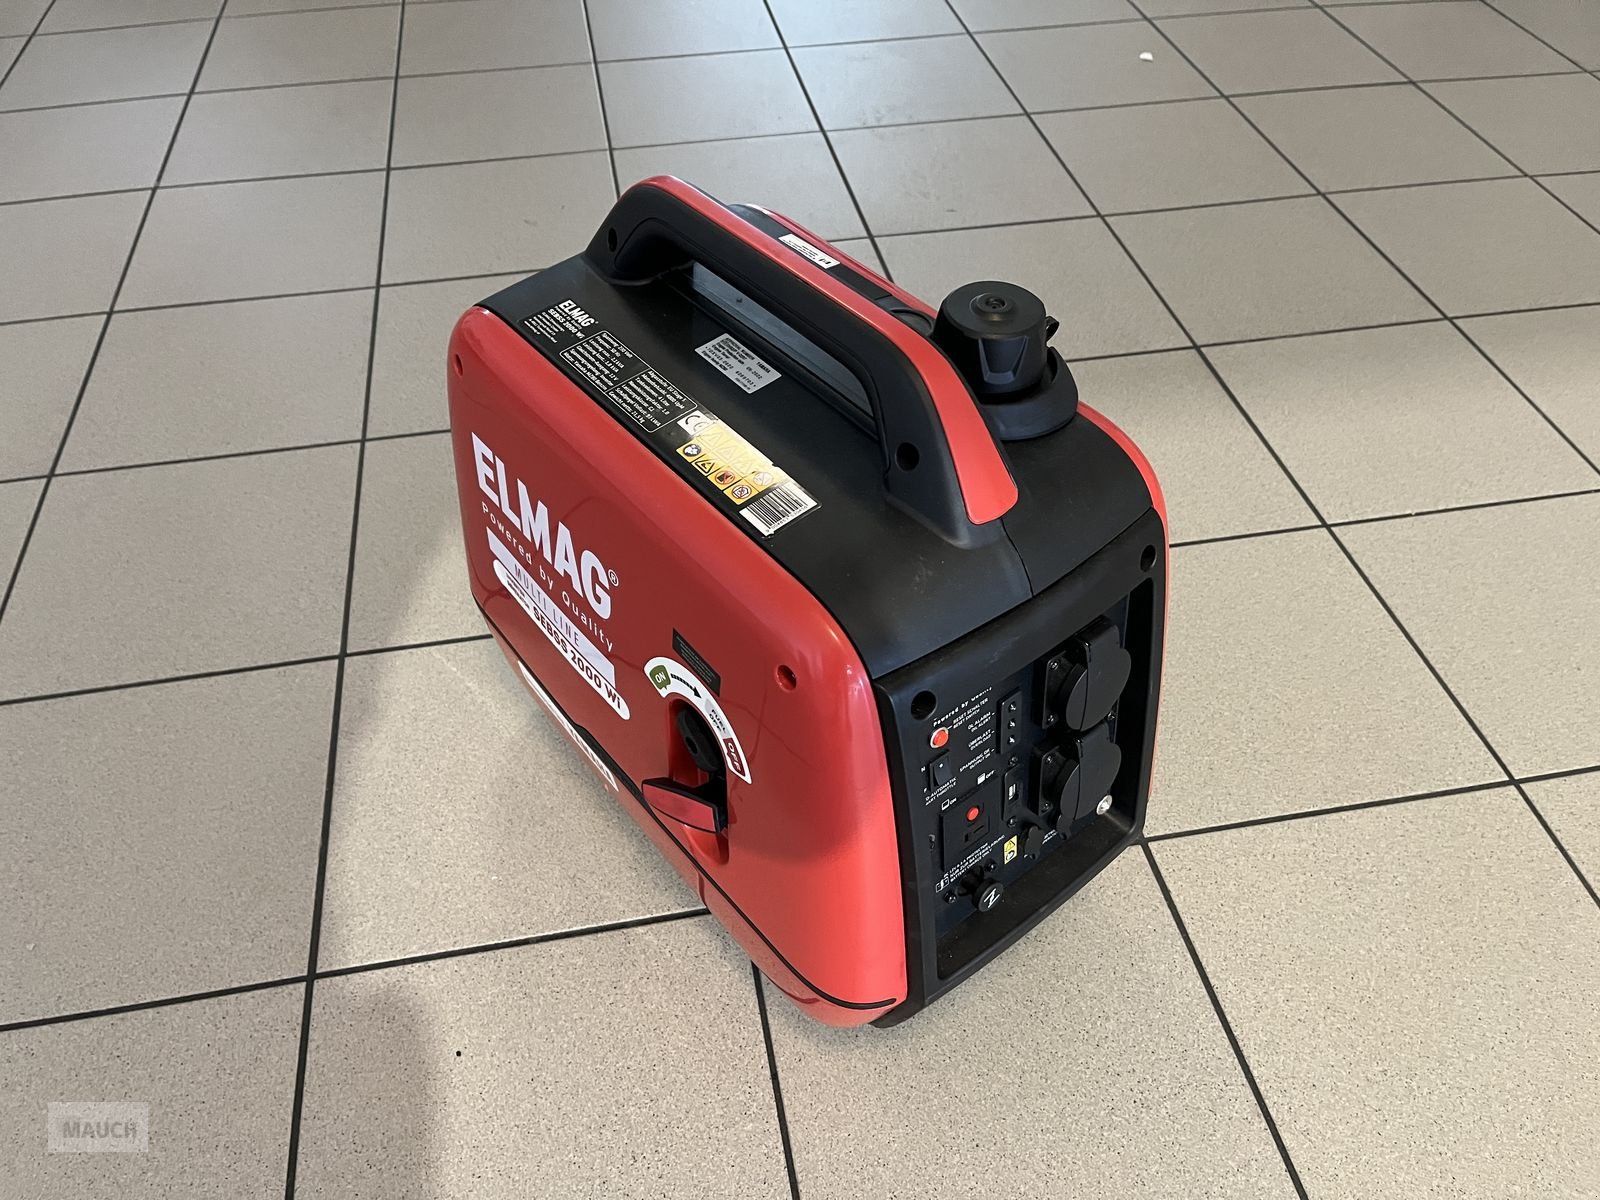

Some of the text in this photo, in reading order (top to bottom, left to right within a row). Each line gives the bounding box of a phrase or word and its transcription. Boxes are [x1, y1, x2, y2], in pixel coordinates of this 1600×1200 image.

[559, 300, 595, 327] ELMAG
[563, 322, 578, 334] 2000
[472, 432, 611, 619] ELMAG
[482, 501, 532, 564] Powered
[539, 564, 554, 590] by
[562, 590, 613, 652] Quality
[514, 564, 546, 610] MULTI
[553, 608, 580, 646] LINE
[533, 606, 621, 710] SEBSS 2000 Wi
[655, 672, 666, 683] ON
[711, 708, 726, 735] FUEL
[933, 707, 959, 727] Powered
[728, 742, 741, 771] OFF
